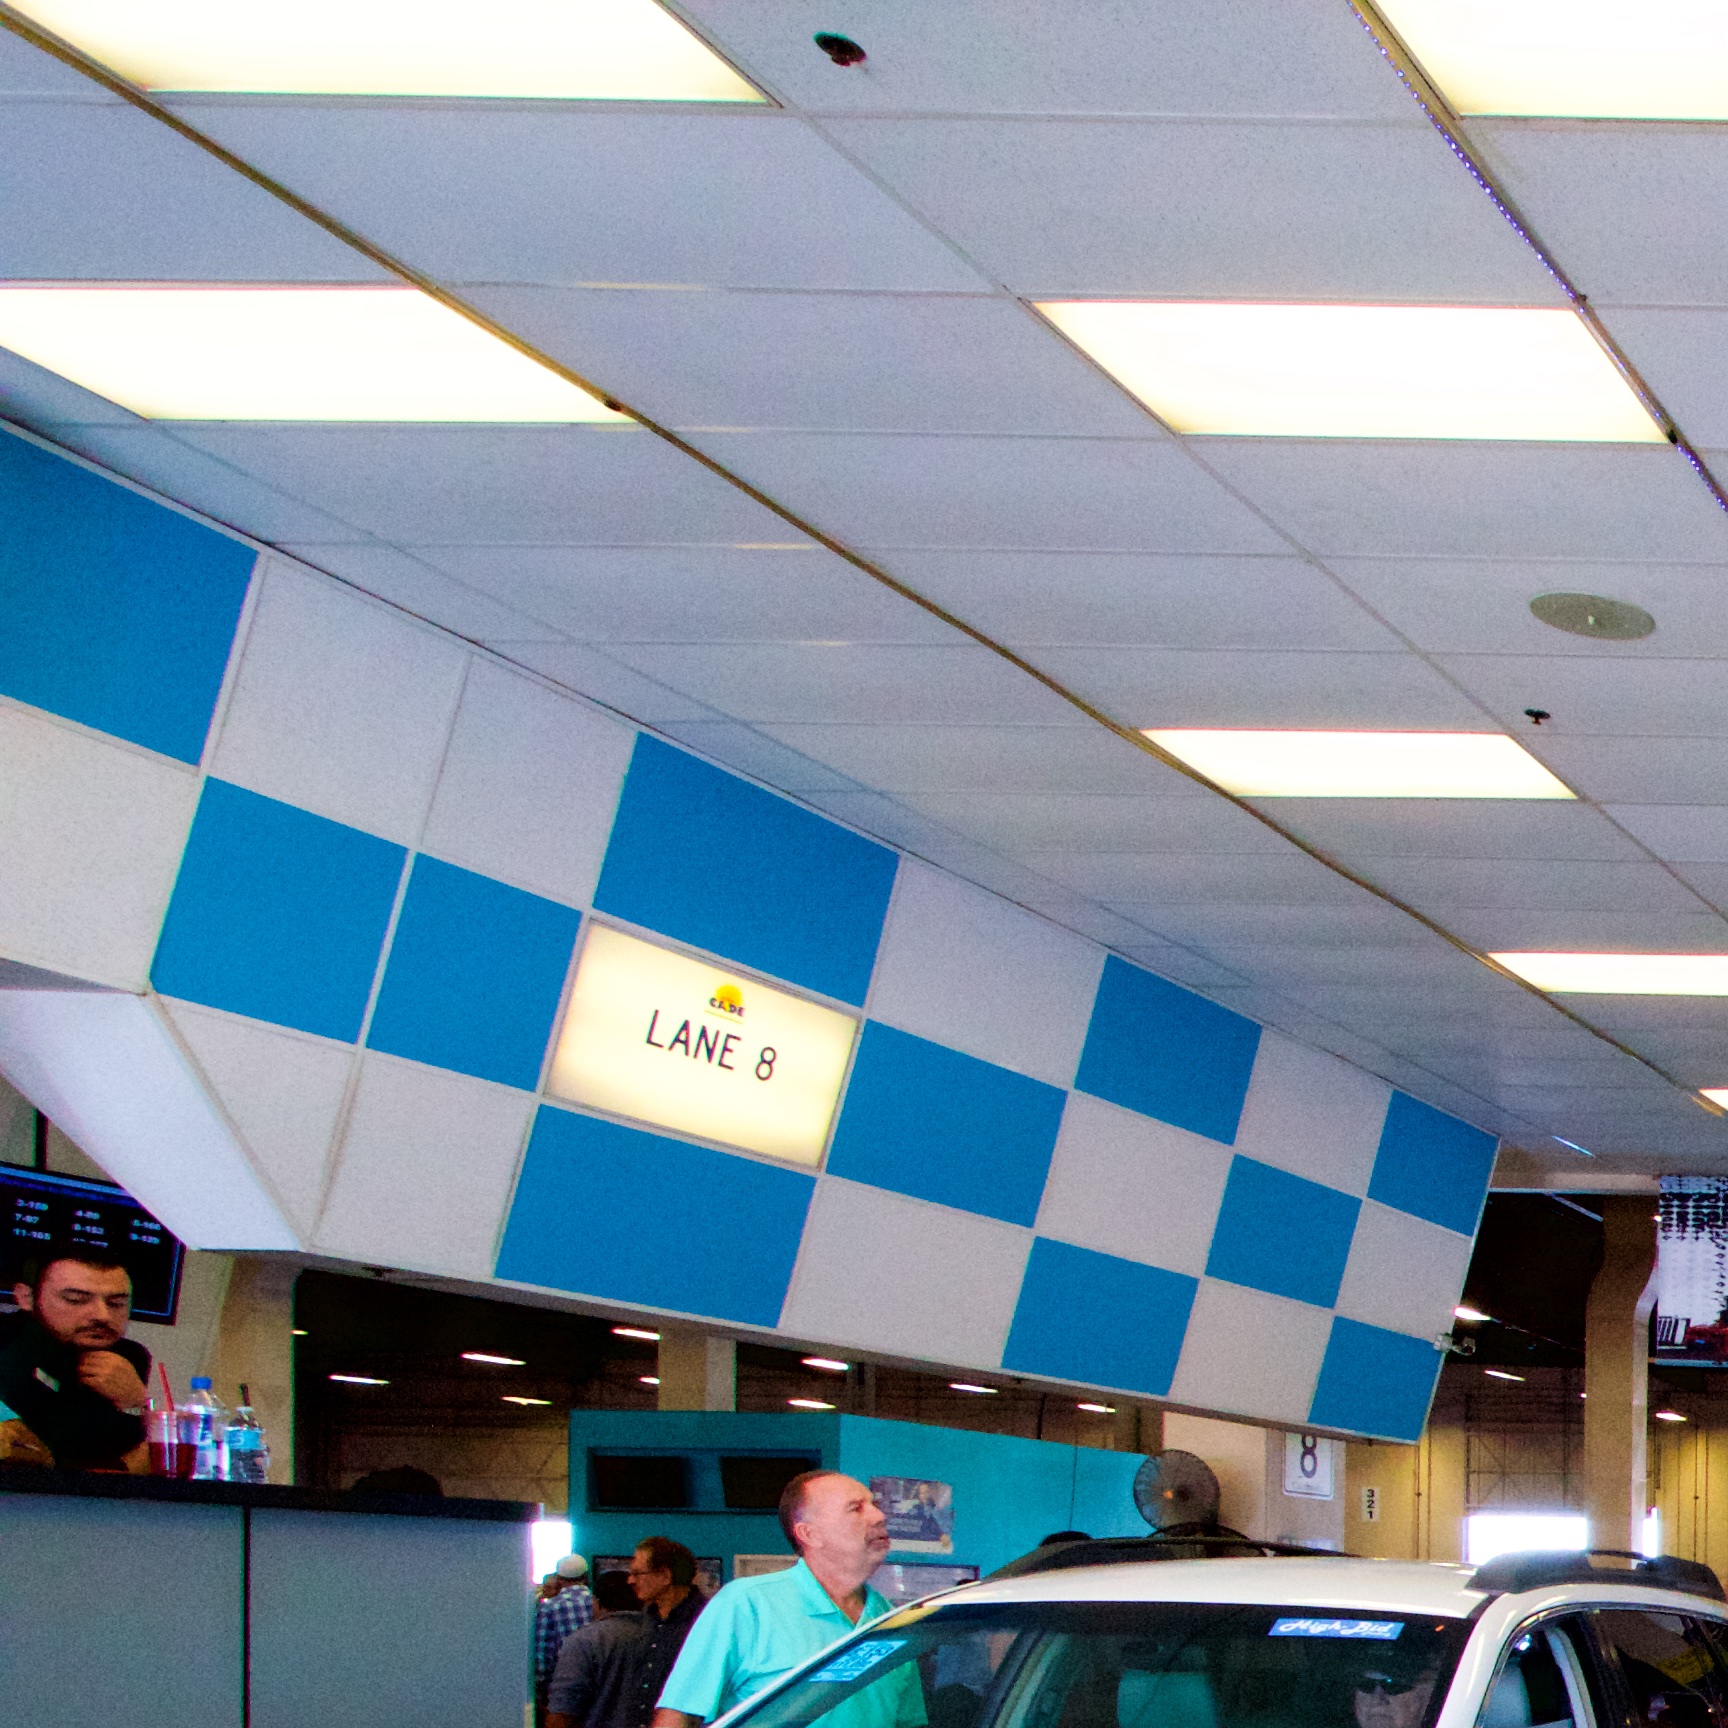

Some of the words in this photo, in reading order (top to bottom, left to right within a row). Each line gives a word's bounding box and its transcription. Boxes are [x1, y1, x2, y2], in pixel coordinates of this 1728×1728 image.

[646, 1009, 742, 1071] LANE
[755, 1046, 777, 1081] 8
[1300, 1434, 1318, 1478] 8
